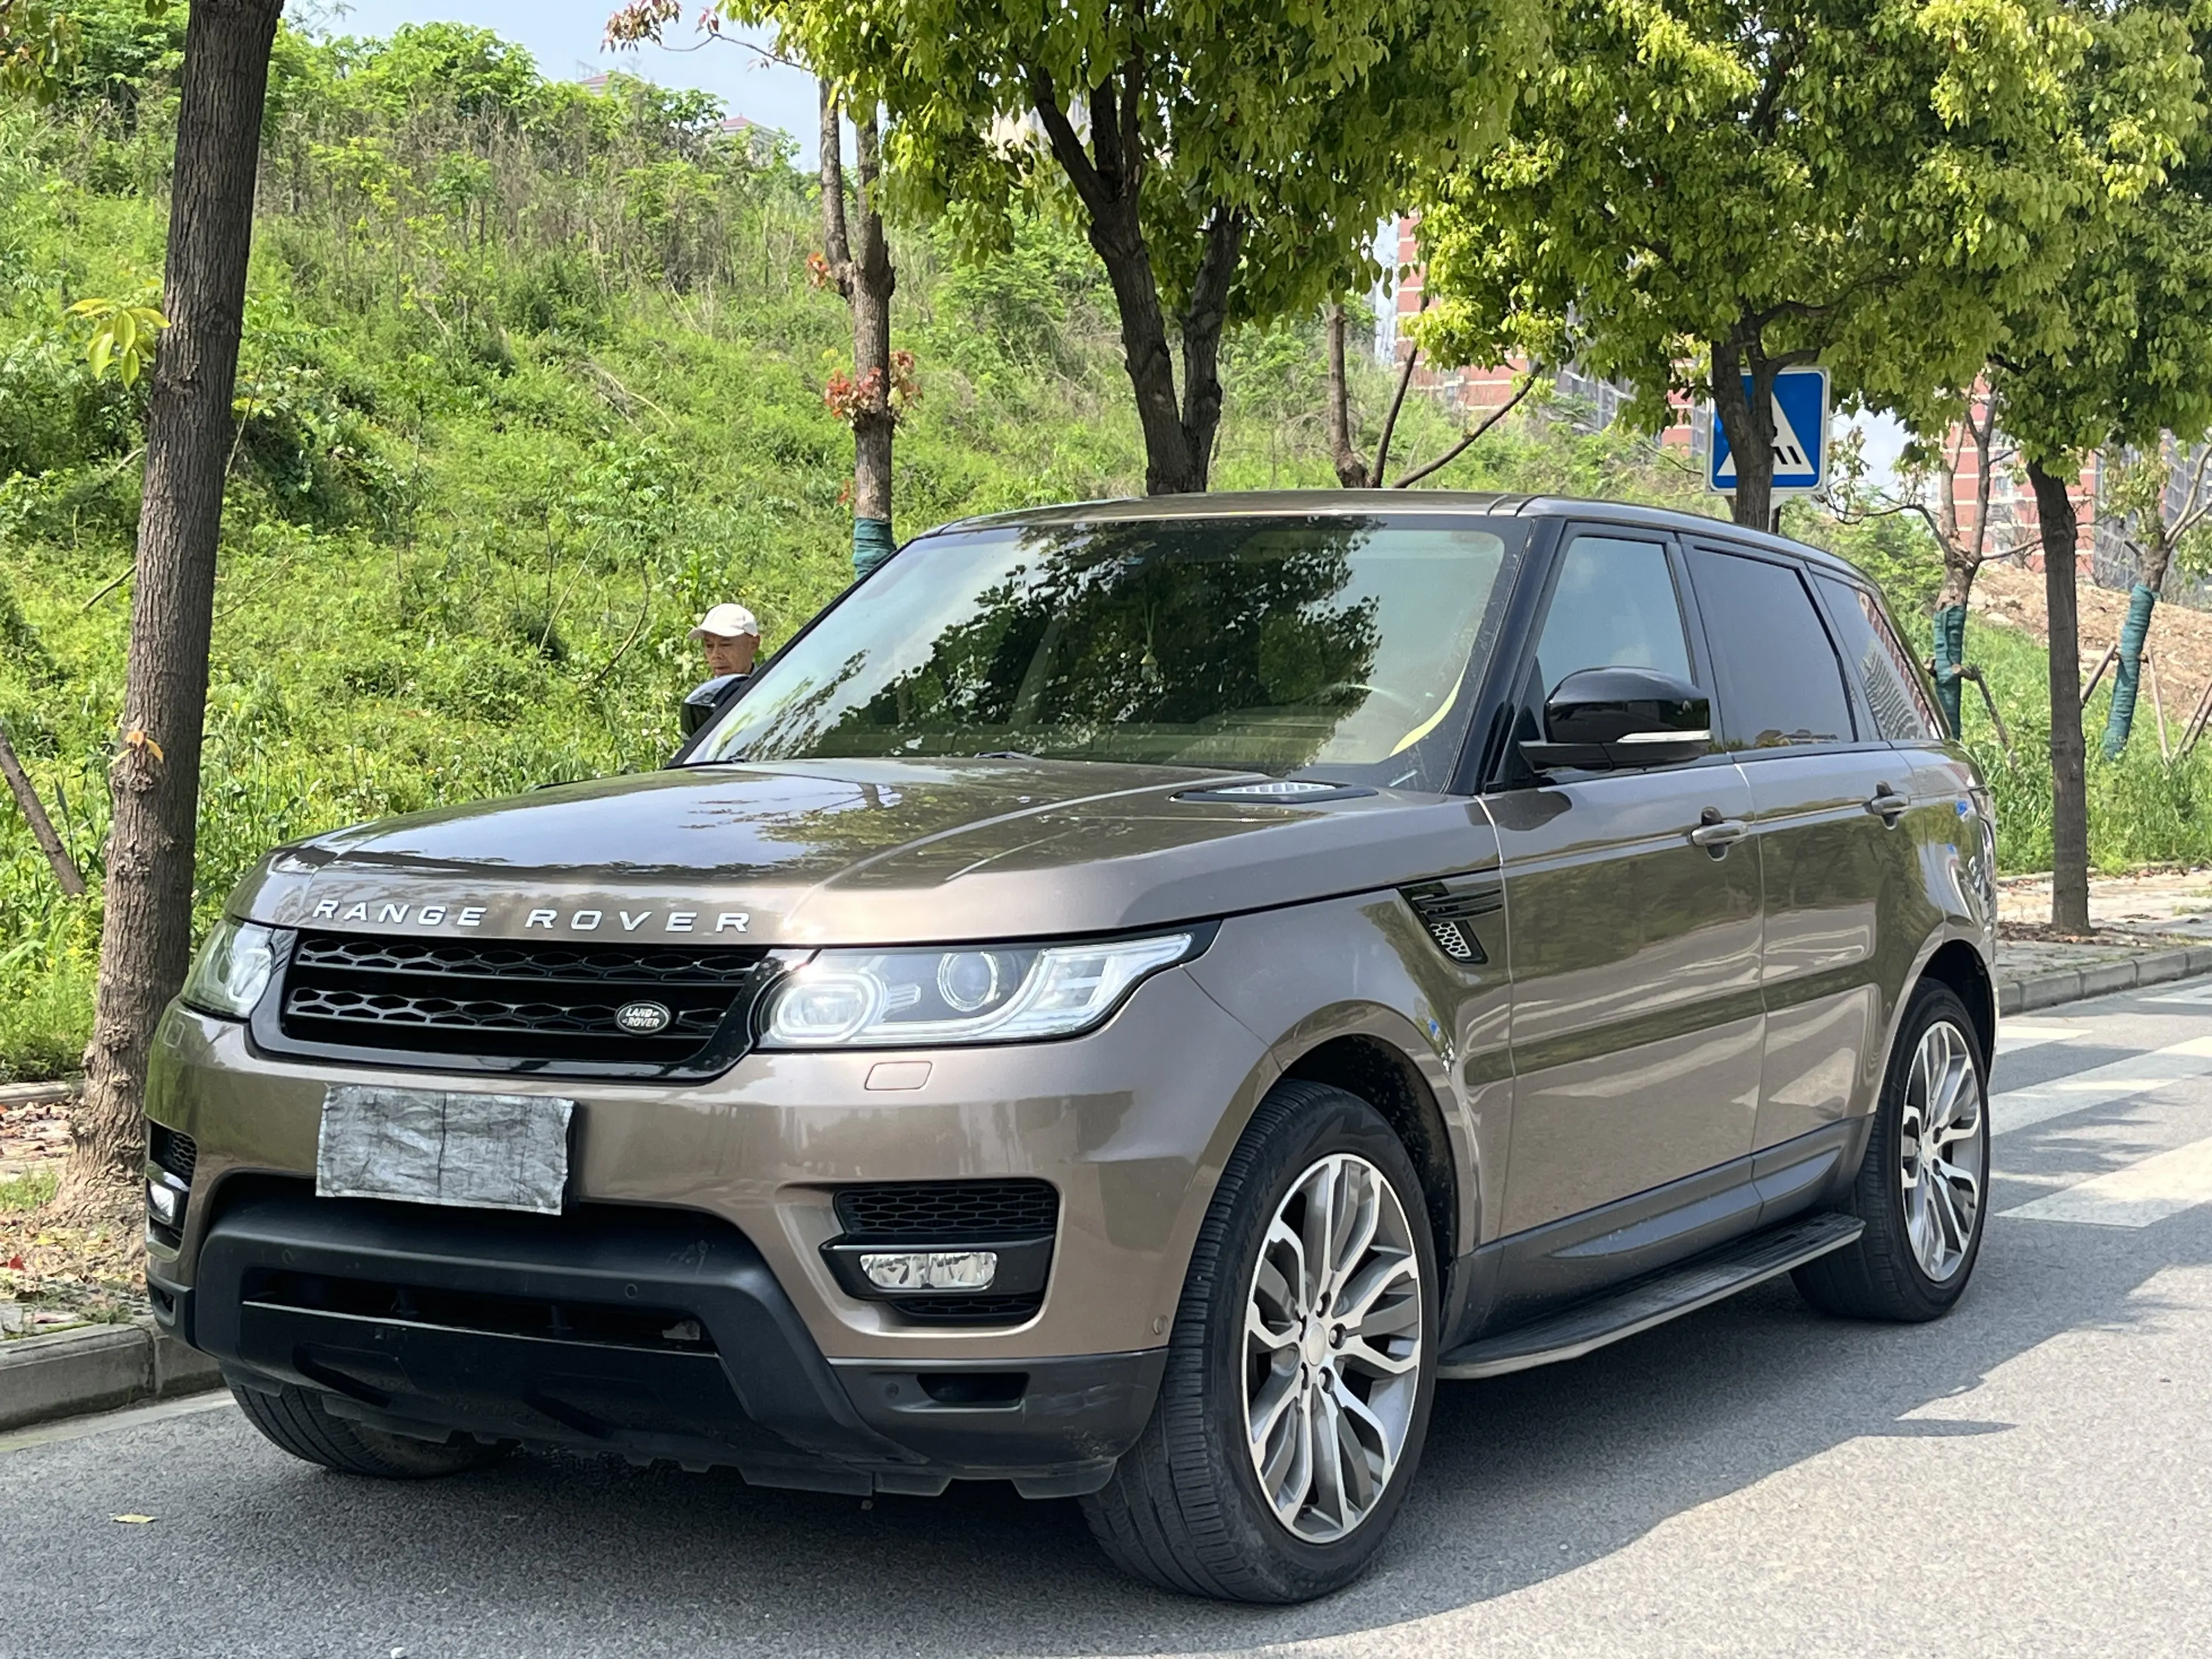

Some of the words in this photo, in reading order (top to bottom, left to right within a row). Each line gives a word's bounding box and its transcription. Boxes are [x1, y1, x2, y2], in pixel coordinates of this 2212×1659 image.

[312, 899, 487, 927] RANGE
[524, 909, 750, 933] ROVER
[625, 1007, 653, 1017] LAND
[627, 1017, 660, 1027] ROVER
